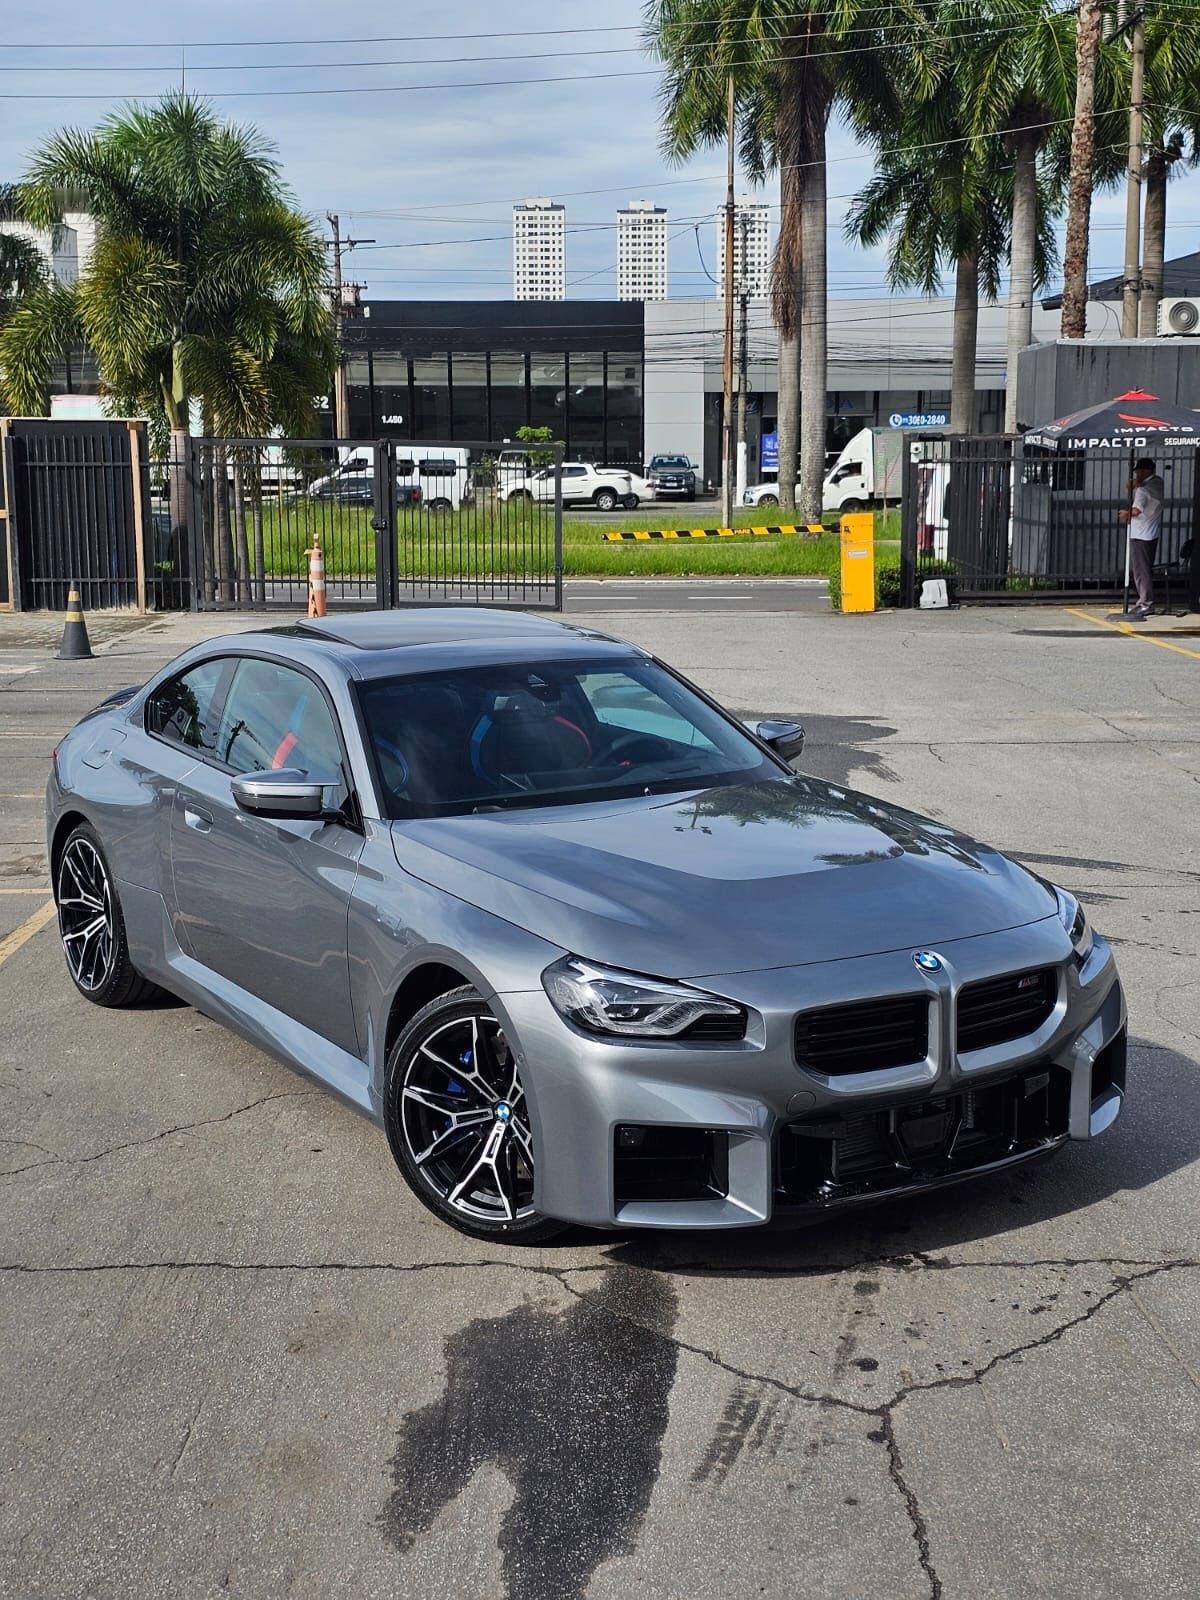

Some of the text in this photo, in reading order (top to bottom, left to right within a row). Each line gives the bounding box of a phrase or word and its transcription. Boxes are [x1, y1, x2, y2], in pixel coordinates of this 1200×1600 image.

[381, 415, 403, 424] 1.450
[1114, 426, 1194, 434] IMPACTO
[1068, 437, 1147, 448] IMPACTO
